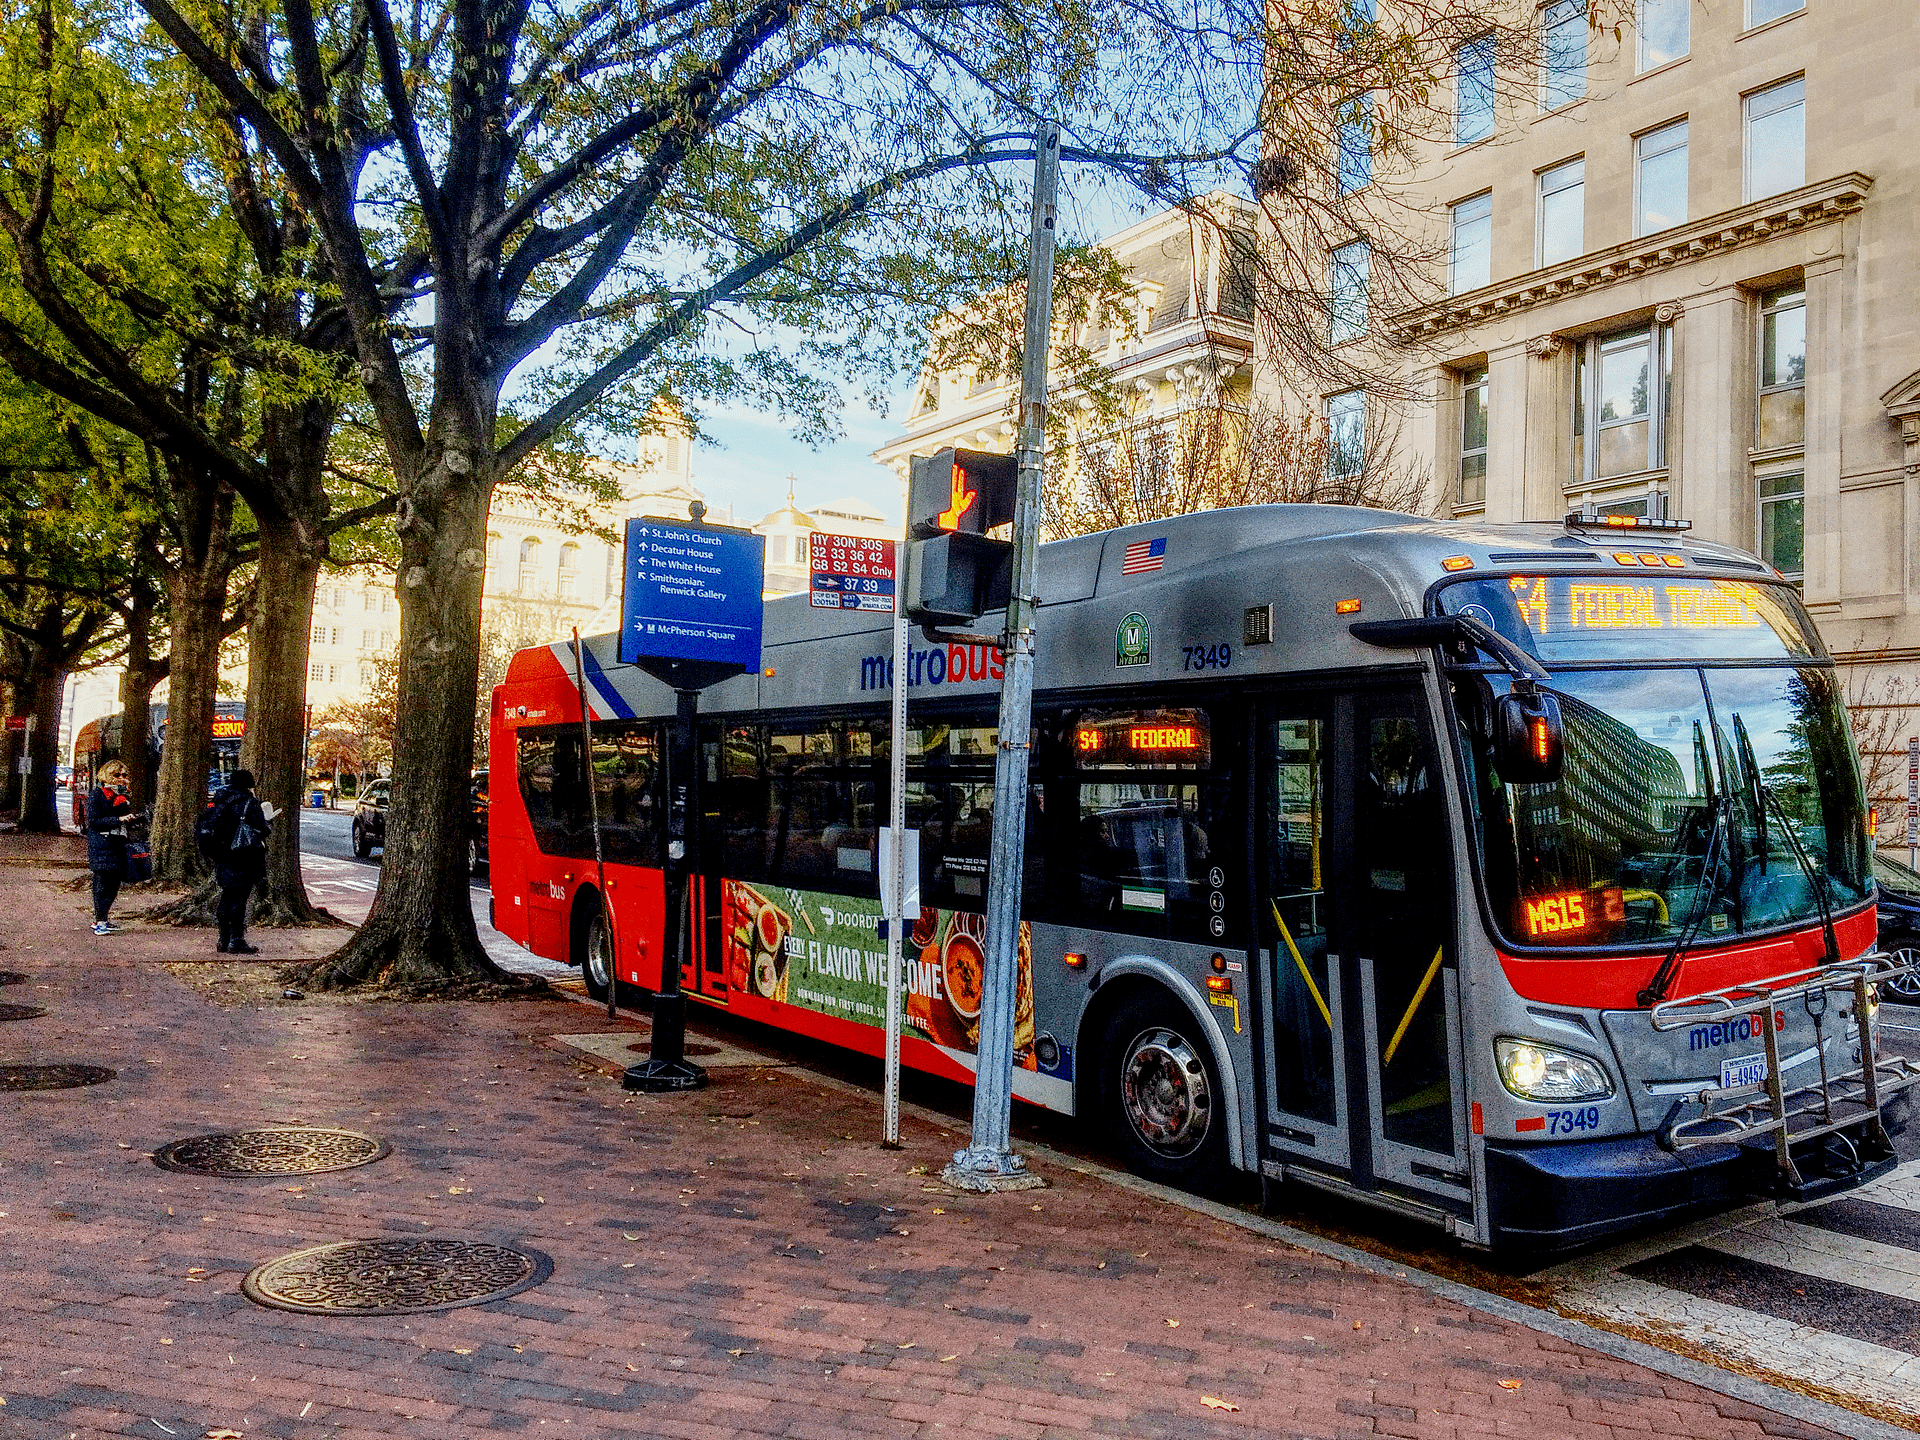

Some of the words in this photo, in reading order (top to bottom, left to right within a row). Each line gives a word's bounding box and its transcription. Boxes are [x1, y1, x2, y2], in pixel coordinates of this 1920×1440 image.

[664, 530, 690, 542] John's
[692, 534, 722, 546] Church
[812, 534, 828, 546] 11Y
[833, 536, 857, 548] 30N
[860, 539, 883, 551] 30S
[651, 544, 685, 556] Decatur
[686, 548, 714, 559] House
[812, 546, 826, 558] 32
[831, 548, 846, 559] 33
[850, 550, 864, 561] 36
[869, 552, 883, 563] 42
[650, 558, 666, 568] The
[668, 560, 693, 571] White
[694, 564, 722, 574] House
[812, 559, 828, 570] G8
[833, 561, 848, 572] S2
[852, 562, 868, 574] S4
[872, 566, 892, 578] Only
[650, 572, 705, 587] Smithsonian:
[844, 578, 858, 590] 37
[862, 580, 878, 592] 39
[660, 584, 696, 596] Renwick
[697, 589, 727, 601] Gallery
[1570, 584, 1664, 628] FEDERAL
[658, 624, 705, 637] McPherson
[706, 630, 736, 640] Square
[1119, 655, 1147, 665] HYBRID
[1182, 642, 1232, 671] 7349
[1080, 730, 1098, 750] S4
[1132, 728, 1196, 748] FEDERAL
[837, 912, 878, 930] DOORDA
[784, 936, 806, 954] EVERY
[809, 940, 862, 982] FLAVOR
[864, 951, 943, 1000] WECOME
[1690, 1010, 1785, 1051] metrobs
[1547, 1106, 1599, 1134] 7349
